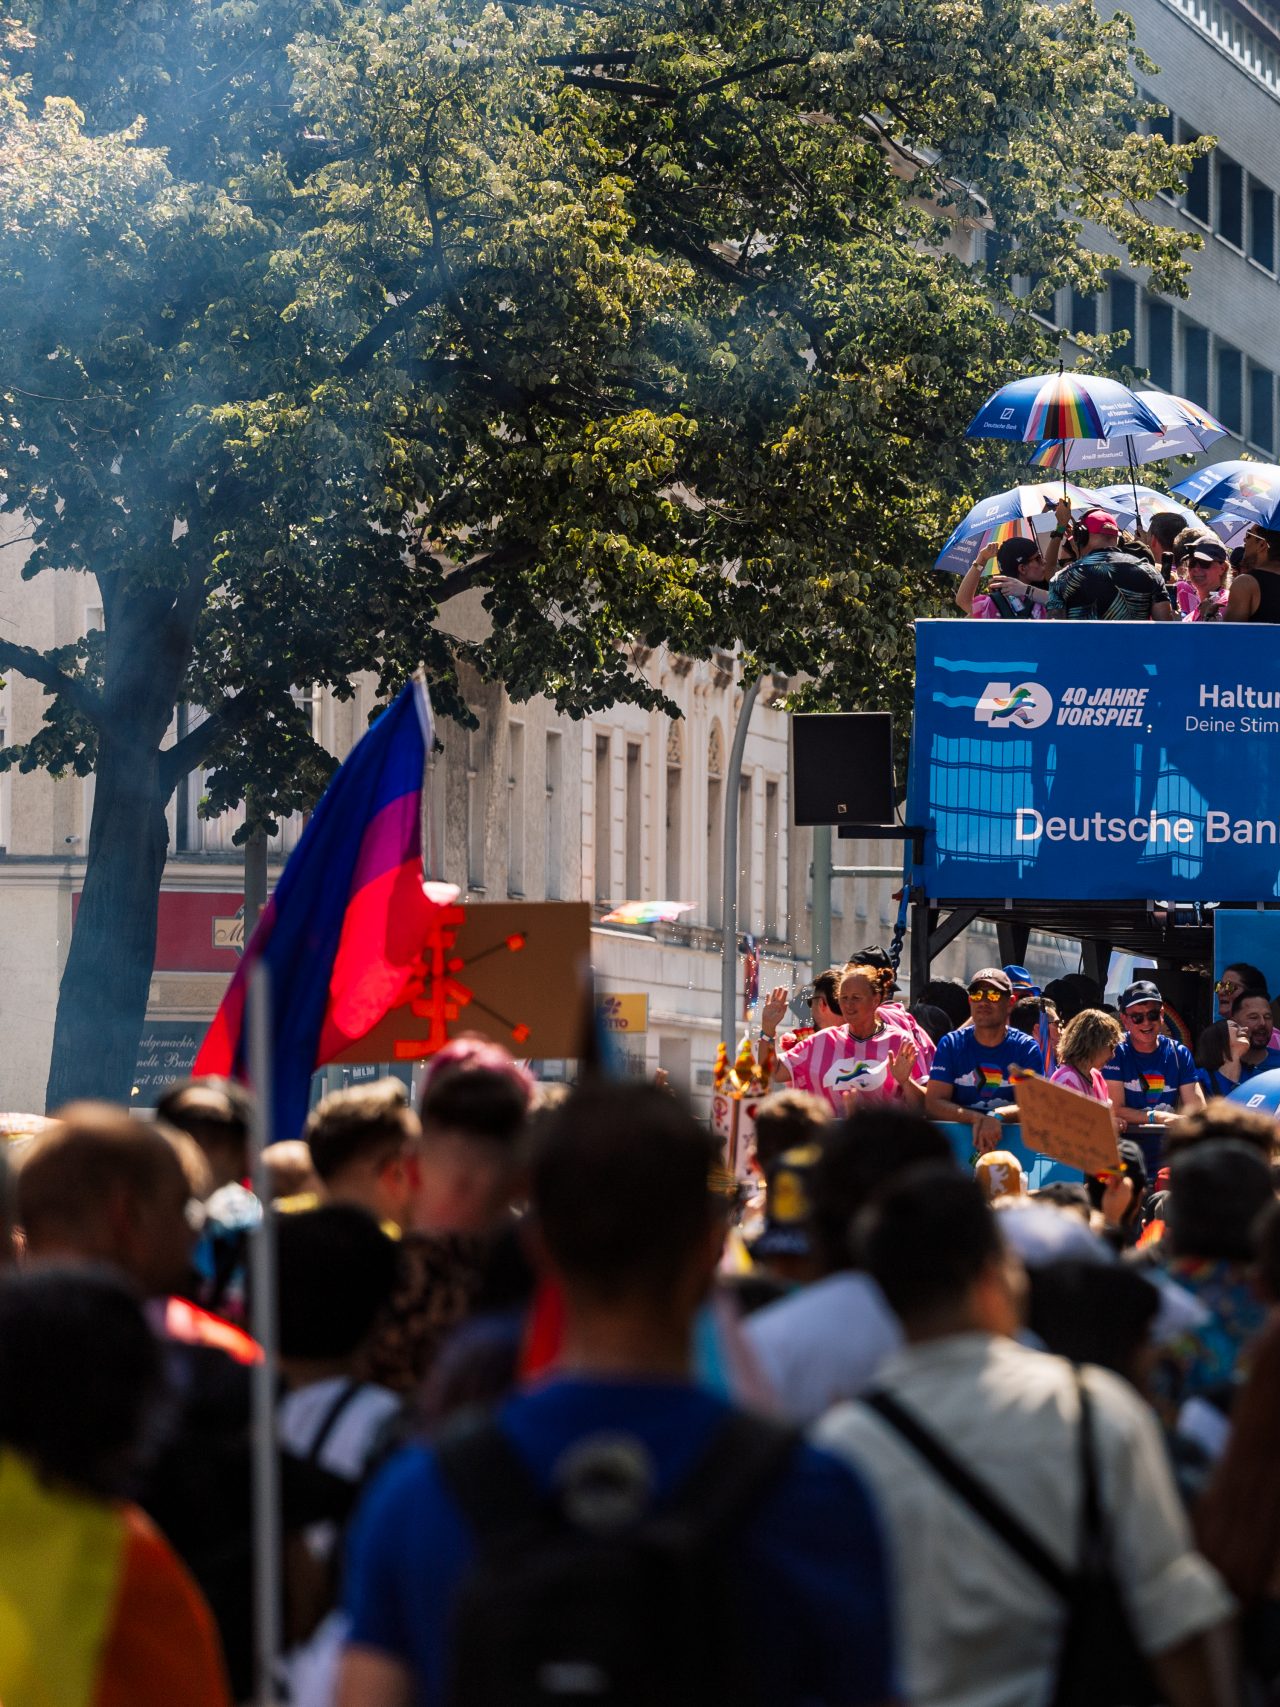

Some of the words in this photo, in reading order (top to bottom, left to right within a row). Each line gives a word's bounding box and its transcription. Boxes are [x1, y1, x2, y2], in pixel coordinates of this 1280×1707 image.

[983, 421, 1006, 430] Deutsche
[1061, 687, 1087, 706] 40
[1087, 688, 1149, 707] JAHRE
[1056, 707, 1143, 727] VORSPIEL
[1185, 715, 1235, 732] Deine
[1015, 807, 1194, 843] Deutsche
[138, 1034, 197, 1053] ndgemachte,
[152, 1074, 177, 1085] 1989
